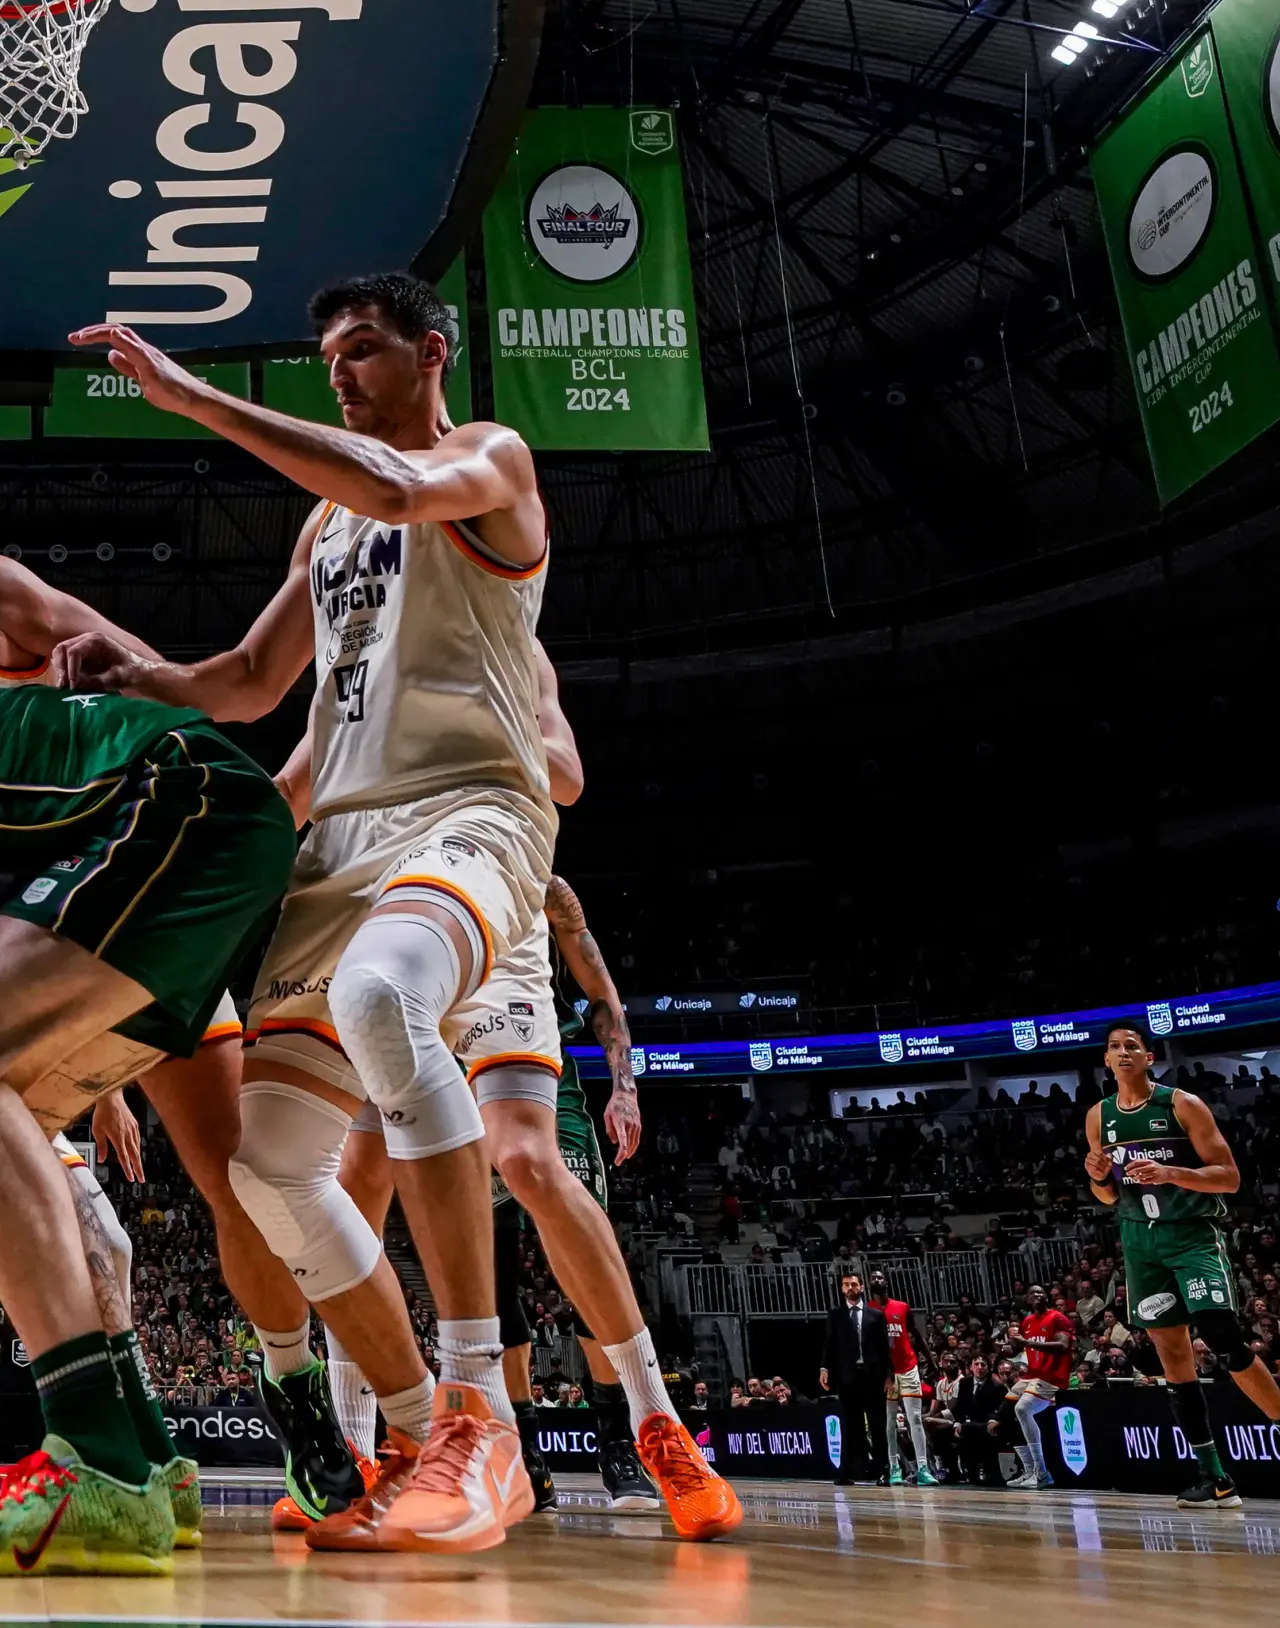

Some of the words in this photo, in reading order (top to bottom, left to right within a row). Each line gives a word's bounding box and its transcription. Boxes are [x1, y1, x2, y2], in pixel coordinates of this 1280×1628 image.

[106, 0, 363, 324] Unicaj
[542, 221, 585, 232] FINAL
[586, 221, 625, 232] FOUR
[498, 307, 688, 348] CAMPEONES
[1136, 258, 1257, 394] CAMPEONES
[500, 348, 571, 358] BASKETBALL
[576, 348, 642, 358] CHAMPIONS
[646, 348, 690, 358] LEAGUE
[1146, 384, 1167, 408] FIBA
[1168, 307, 1261, 388] INTERCONTINENTAL
[570, 359, 626, 381] BCL
[1195, 362, 1212, 384] CUP
[86, 374, 147, 398] 2016
[565, 388, 631, 412] 2024
[1188, 380, 1234, 434] 2024
[340, 625, 377, 644] REGIÓN
[342, 641, 358, 654] DE
[674, 998, 712, 1011] Unicaja
[758, 995, 797, 1008] Unicaja
[510, 1005, 532, 1014] acb
[1176, 1003, 1210, 1016] Ciudad
[1178, 1016, 1190, 1026] de
[1192, 1012, 1226, 1026] Málaga
[1040, 1022, 1074, 1032] Ciudad
[906, 1036, 939, 1046] Ciudad
[1042, 1034, 1055, 1044] de
[1056, 1030, 1090, 1043] Málaga
[649, 1052, 680, 1061] Ciudad
[776, 1046, 808, 1056] Ciudad
[908, 1046, 920, 1056] de
[921, 1044, 954, 1056] Málaga
[650, 1062, 661, 1070] de
[662, 1060, 694, 1072] Málaga
[777, 1056, 789, 1064] de
[790, 1054, 822, 1066] Málaga
[1128, 1147, 1174, 1162] Unicaja
[1142, 1194, 1160, 1219] 0
[1188, 1288, 1208, 1300] laga
[538, 1432, 597, 1453] UNIC
[728, 1433, 743, 1455] MUY
[746, 1433, 765, 1455] DEL
[767, 1432, 812, 1456] UNICAJA
[1124, 1426, 1160, 1459] MUY
[1225, 1425, 1280, 1460] UNIC
